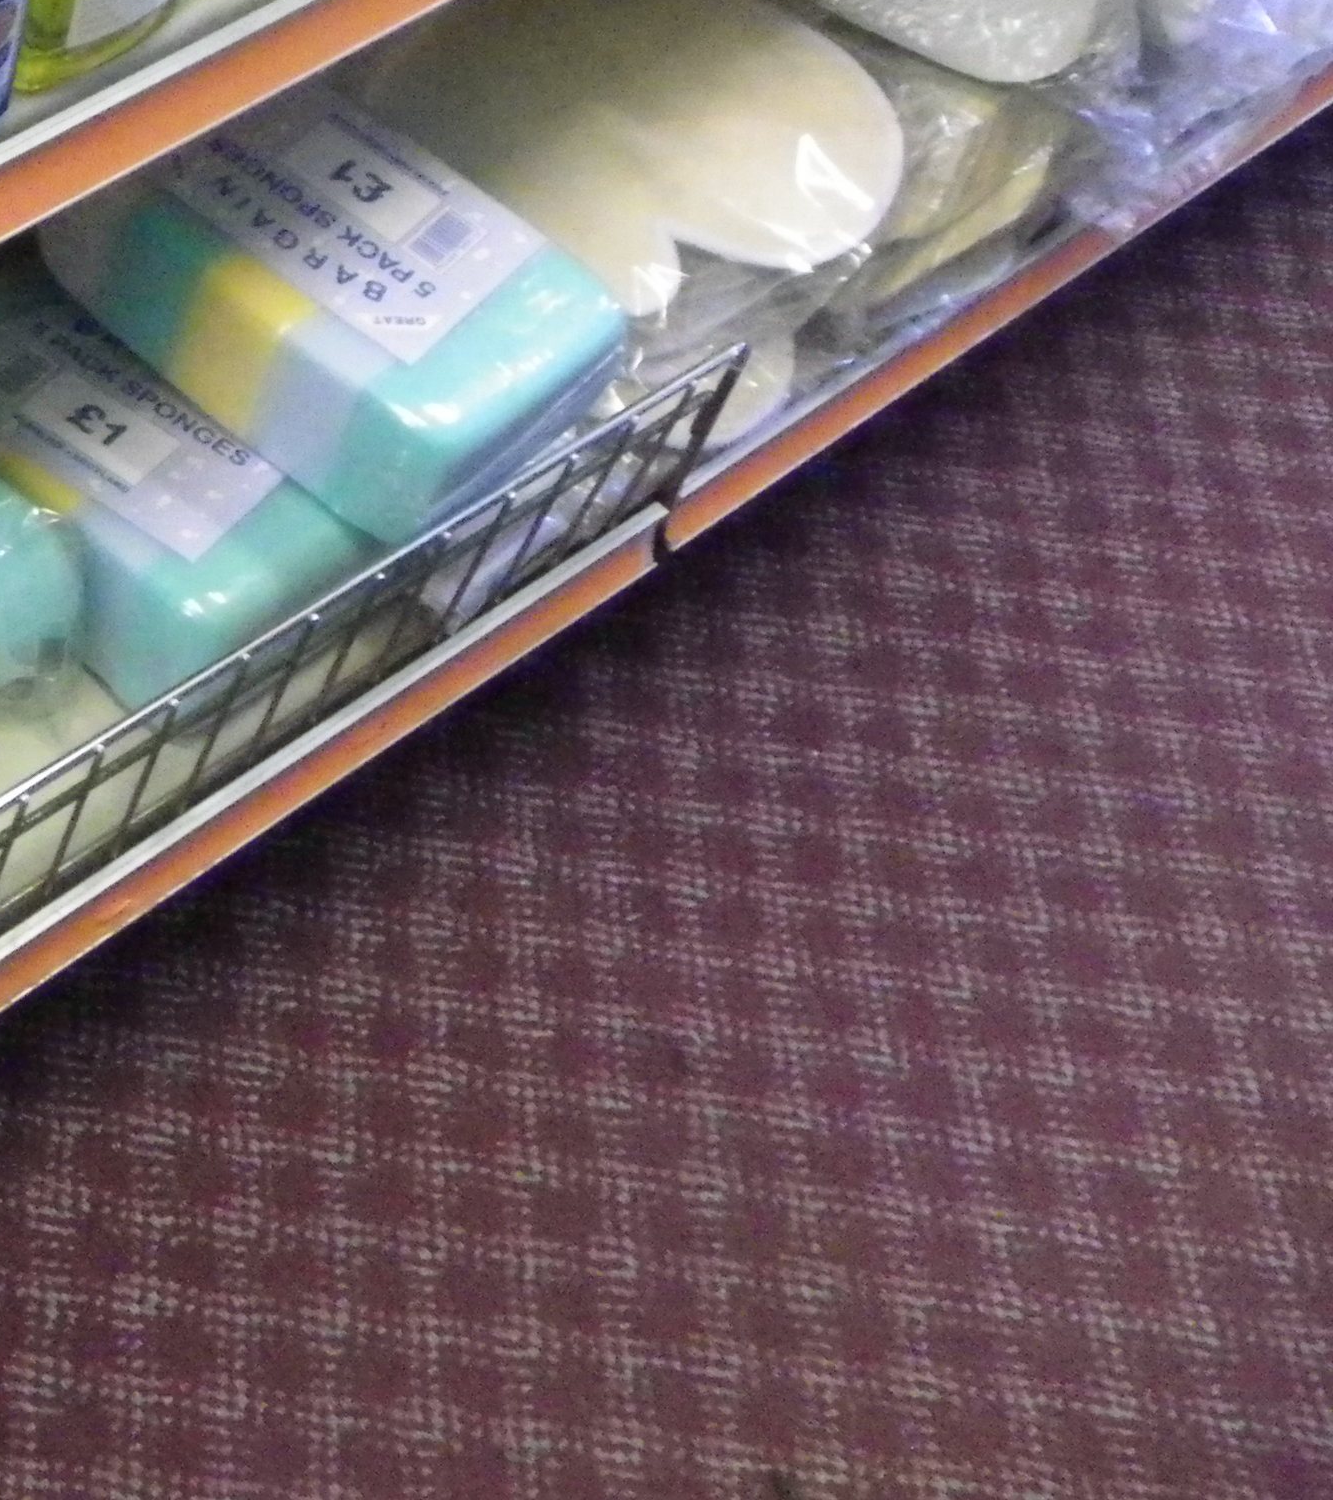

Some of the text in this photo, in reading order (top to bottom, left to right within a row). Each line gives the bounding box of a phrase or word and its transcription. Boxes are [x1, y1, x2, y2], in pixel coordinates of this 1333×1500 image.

[330, 160, 394, 202] £1
[337, 225, 415, 283] PACK
[65, 404, 127, 446] £1
[121, 380, 250, 467] SPONGES
